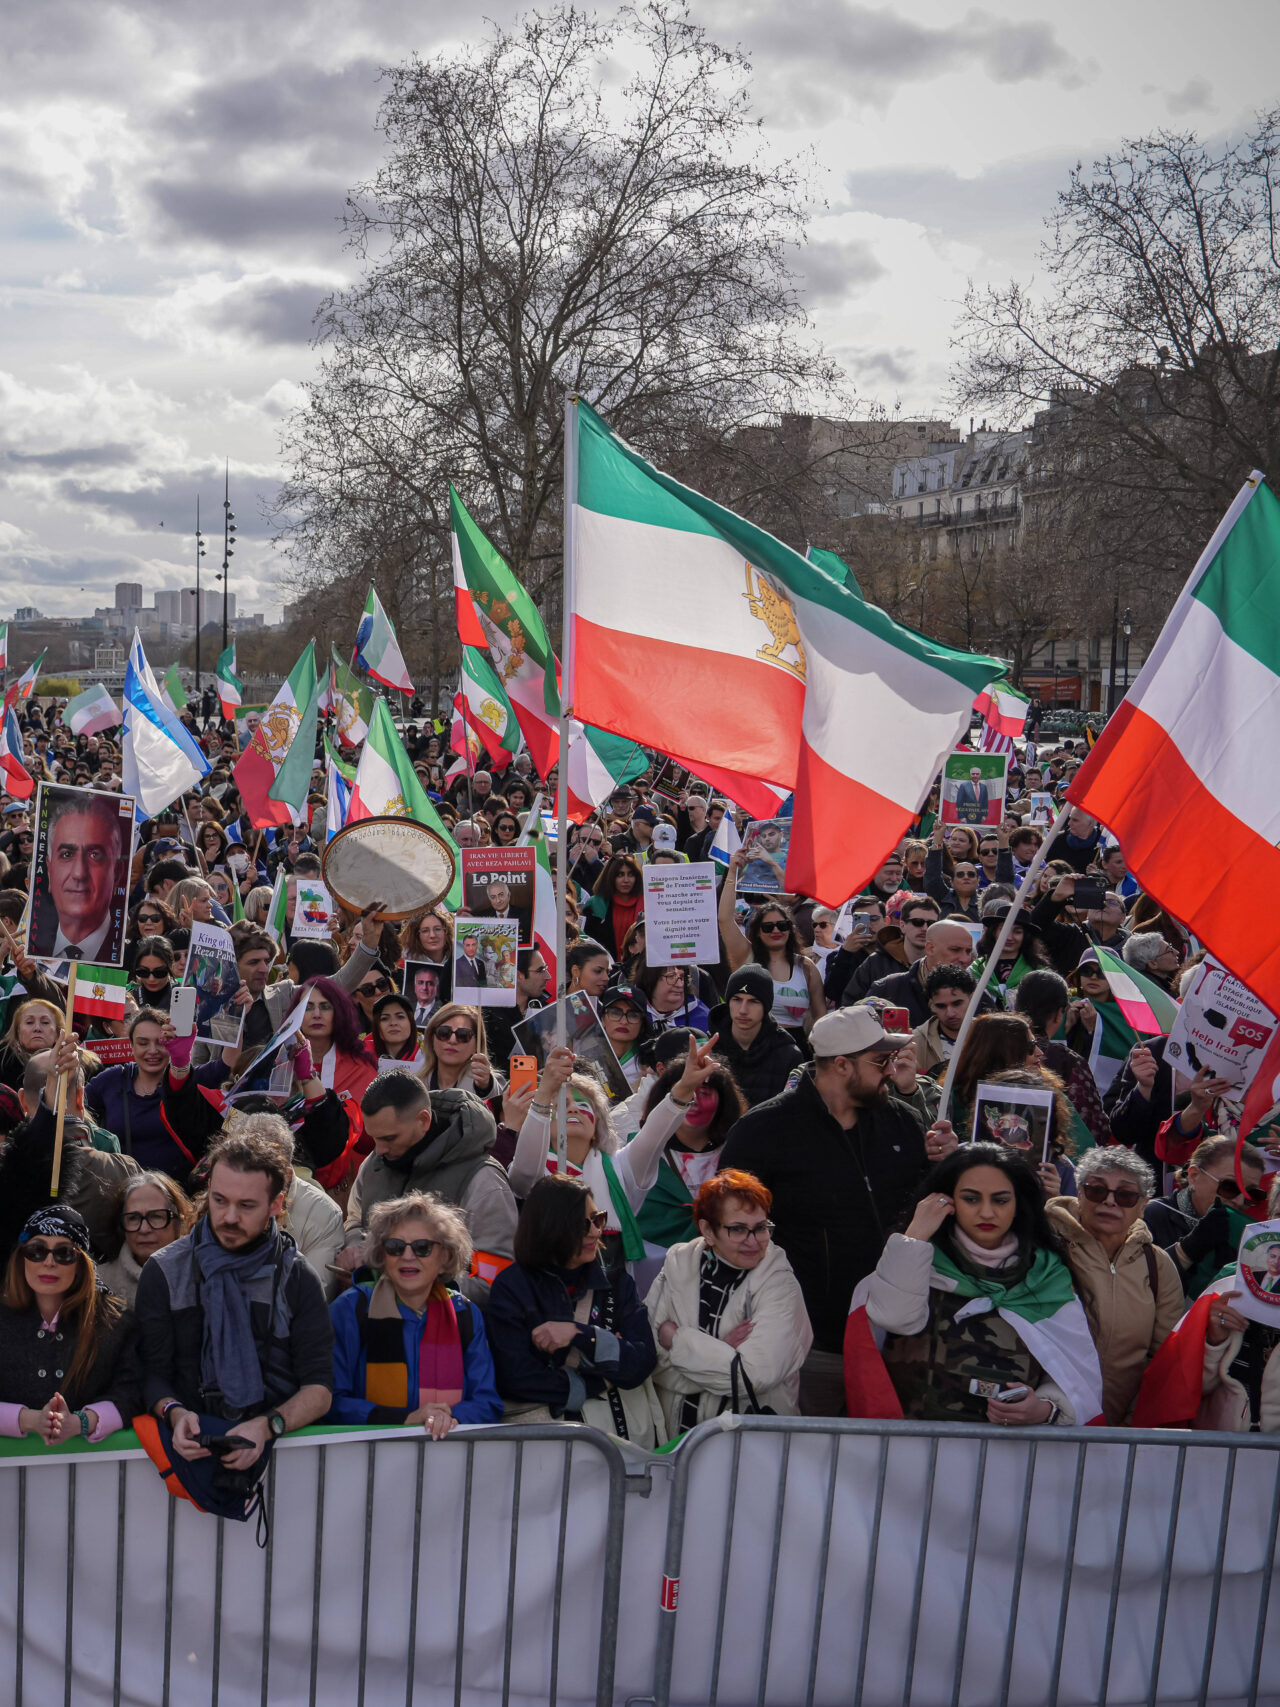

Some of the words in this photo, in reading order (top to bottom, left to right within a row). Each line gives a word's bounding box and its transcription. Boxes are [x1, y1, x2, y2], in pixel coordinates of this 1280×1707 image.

[40, 787, 50, 829] KING
[36, 831, 46, 874] REZA
[472, 873, 488, 884] Le
[490, 871, 527, 884] Point
[31, 876, 42, 952] PAHLAVI
[111, 909, 121, 961] EXILE
[198, 932, 218, 948] King
[194, 945, 215, 958] Reza
[1213, 990, 1222, 998] LA
[1216, 1000, 1251, 1019] ISLAMIQUE
[1192, 1028, 1214, 1046] Help
[1216, 1041, 1239, 1057] Iran
[1236, 1025, 1265, 1041] SOS
